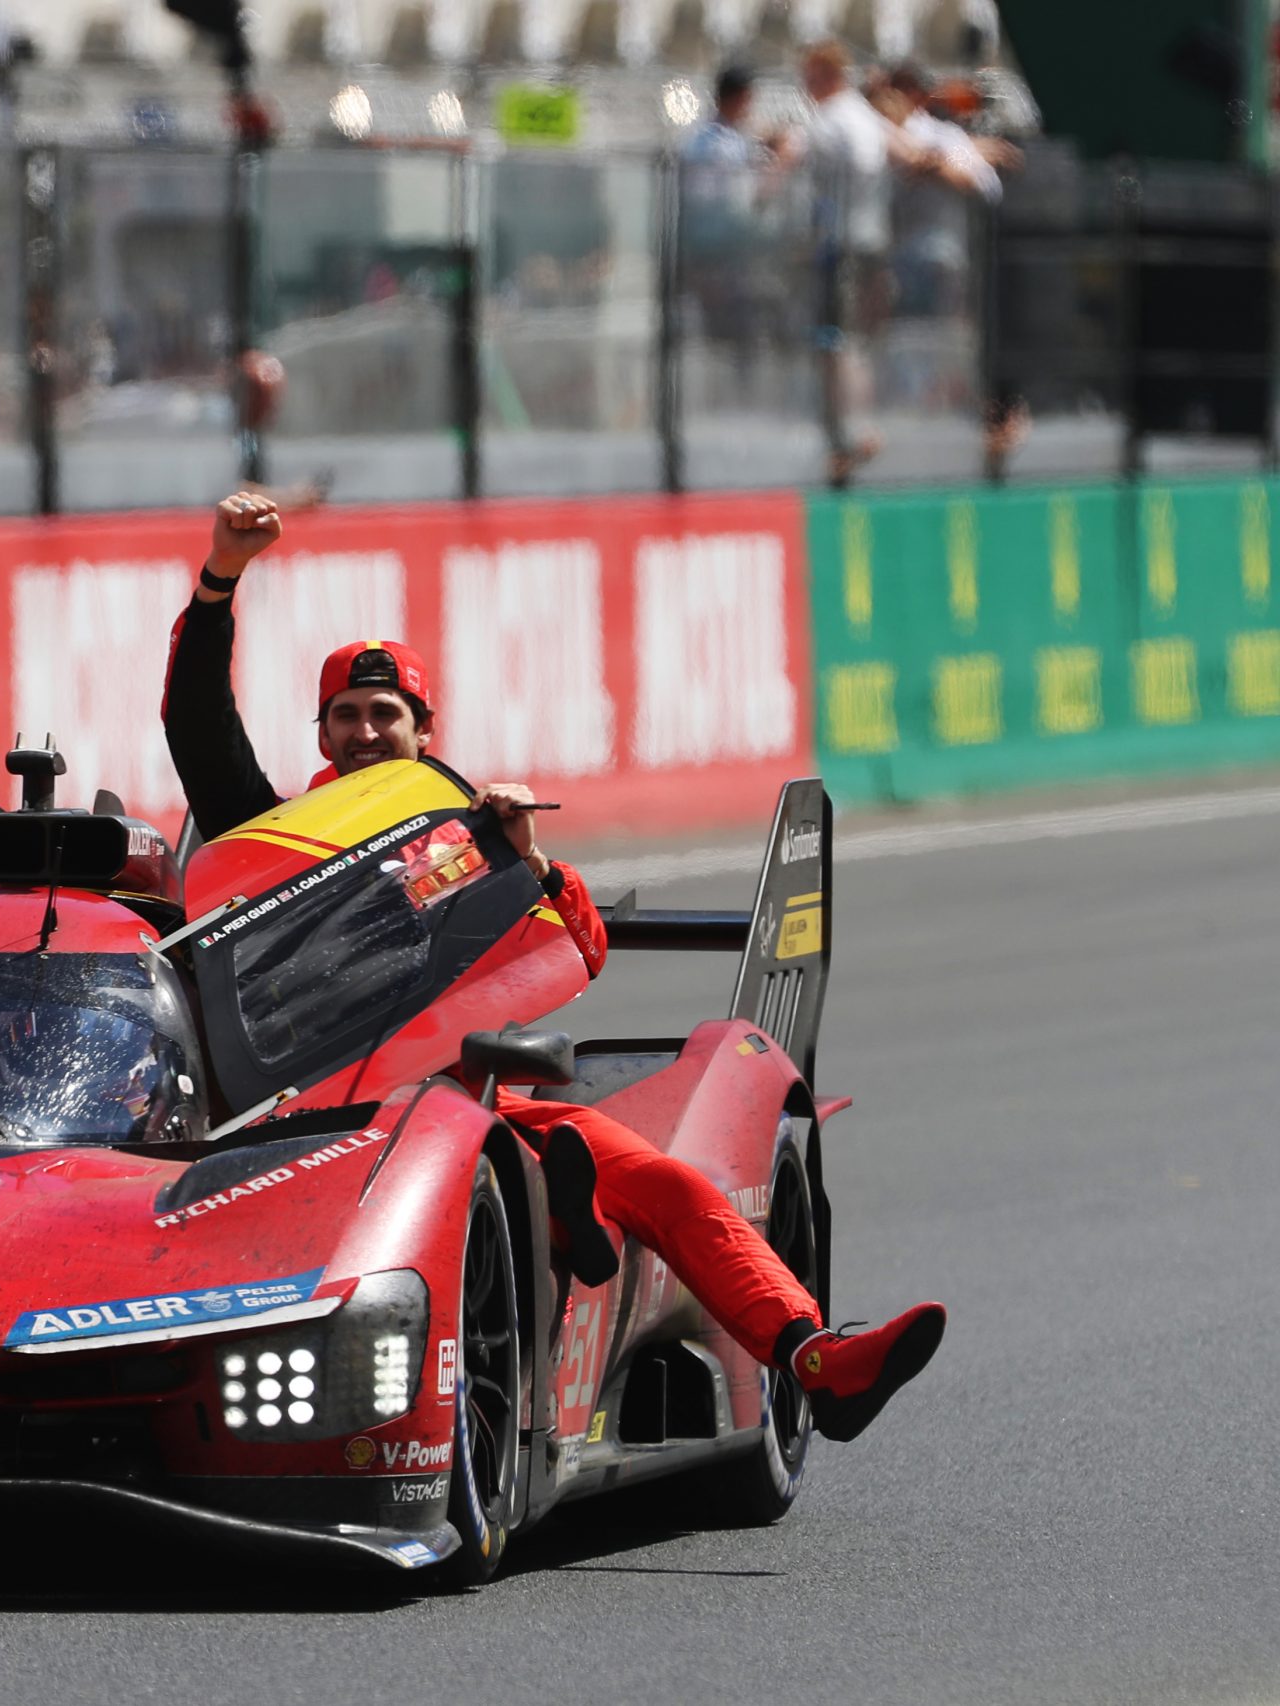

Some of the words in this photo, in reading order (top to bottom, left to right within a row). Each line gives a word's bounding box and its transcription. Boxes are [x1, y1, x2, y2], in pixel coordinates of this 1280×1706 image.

[212, 931, 226, 942] A.
[222, 914, 249, 935] PIER
[247, 897, 280, 920] GUIDI
[291, 885, 303, 896] J.
[299, 860, 347, 890] CALADO
[356, 848, 371, 859] A.
[367, 815, 431, 853] GIOVINAZZI
[154, 1168, 296, 1229] RICHARD
[297, 1127, 390, 1170] MILLE
[235, 1284, 297, 1298] PELZER
[241, 1293, 303, 1308] GROUP
[30, 1296, 193, 1337] ADLER
[563, 1300, 602, 1410] 51
[382, 1440, 453, 1469] V-Power
